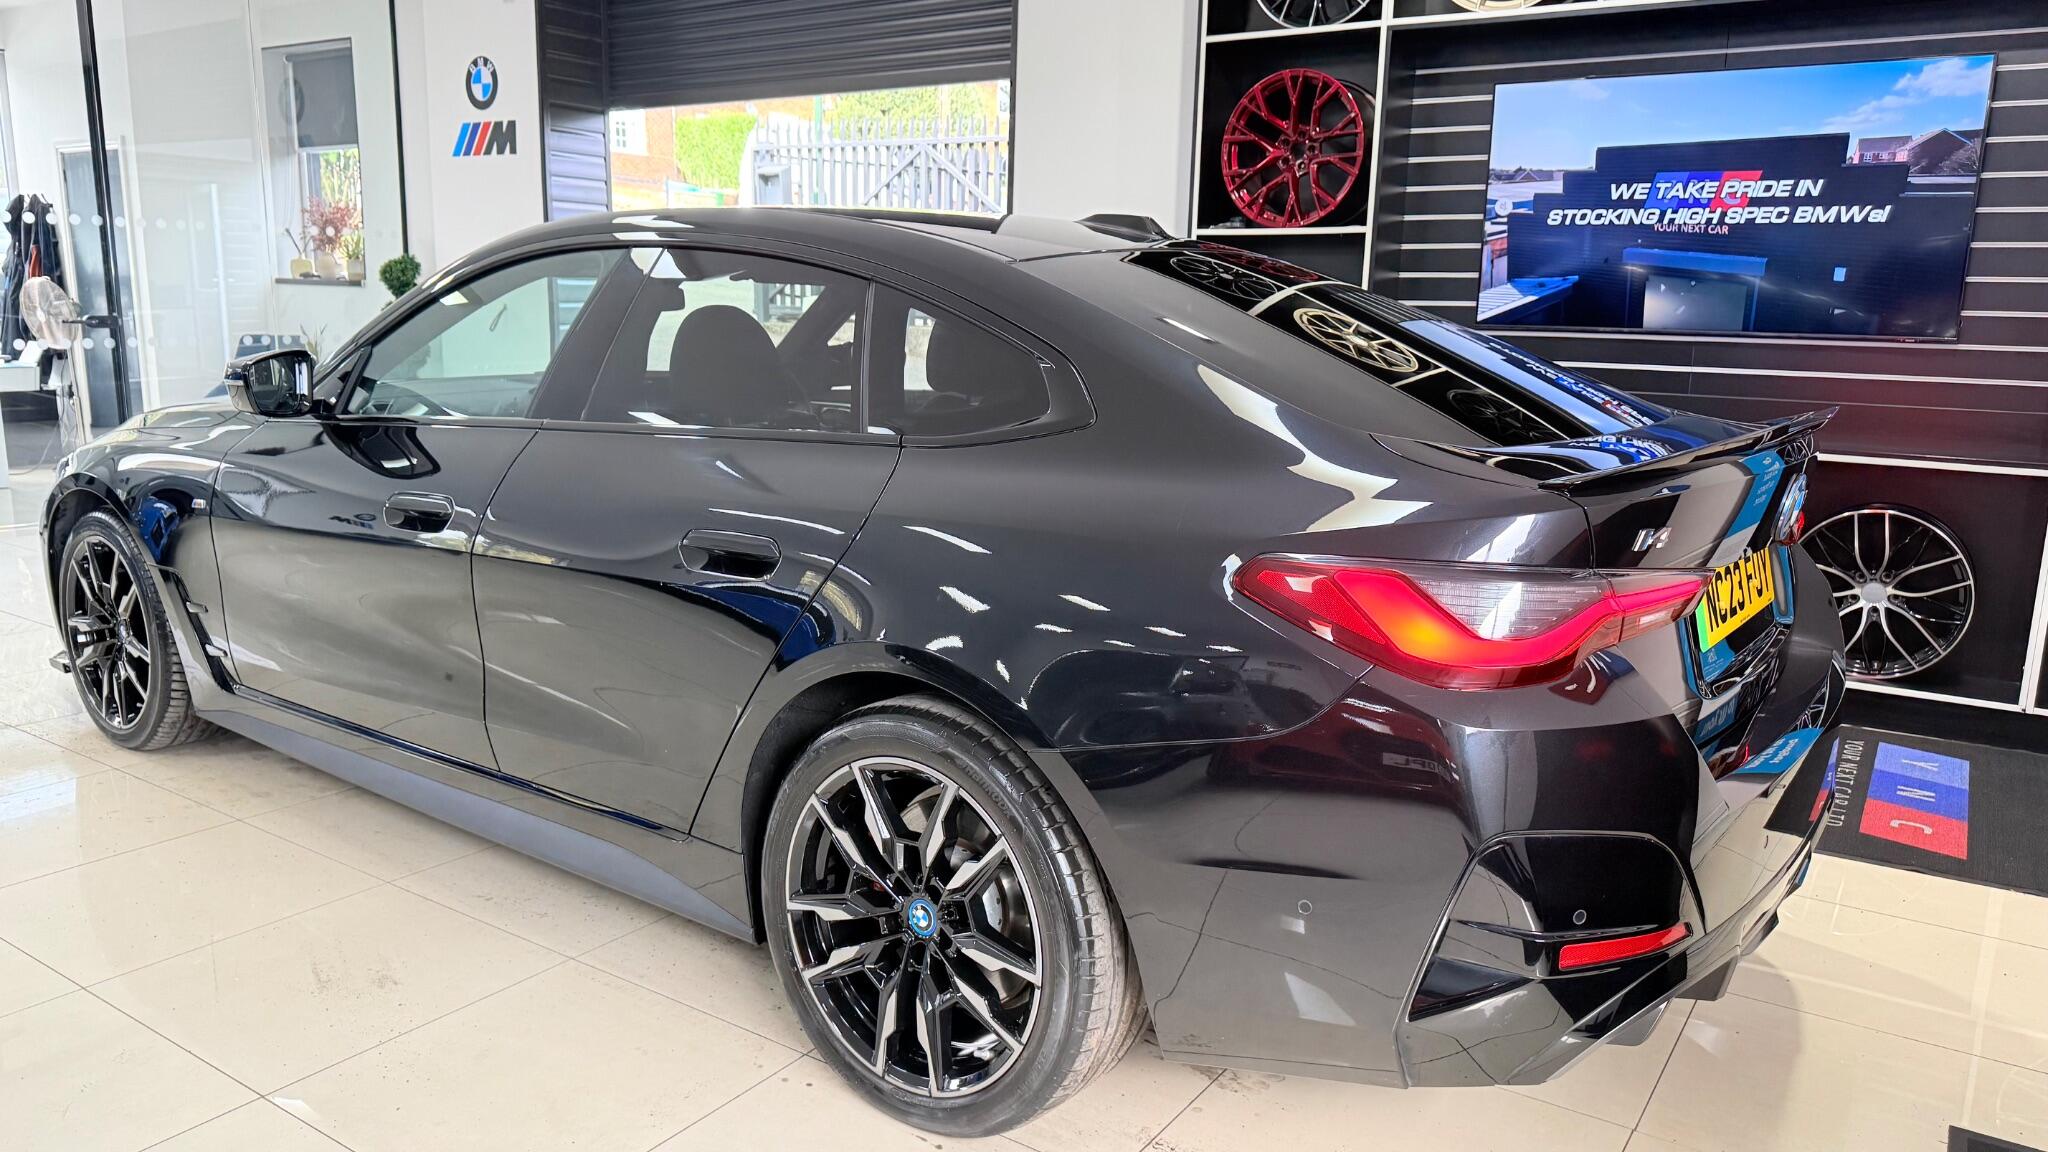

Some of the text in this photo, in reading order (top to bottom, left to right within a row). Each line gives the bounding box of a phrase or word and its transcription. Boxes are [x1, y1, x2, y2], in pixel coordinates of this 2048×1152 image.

[1611, 182, 1651, 200] WE
[1656, 181, 1720, 200] TAKE
[1720, 179, 1794, 198] PRIDE
[1795, 179, 1824, 197] IN
[1547, 207, 1661, 226] STOCKING
[1663, 207, 1721, 225] HIGH
[1724, 206, 1790, 224] SPEC
[1654, 223, 1729, 235] YOUR NEXT CAR
[1706, 561, 1745, 633] NC23
[1826, 740, 1864, 827] YOUR NEXT CAR LTD
